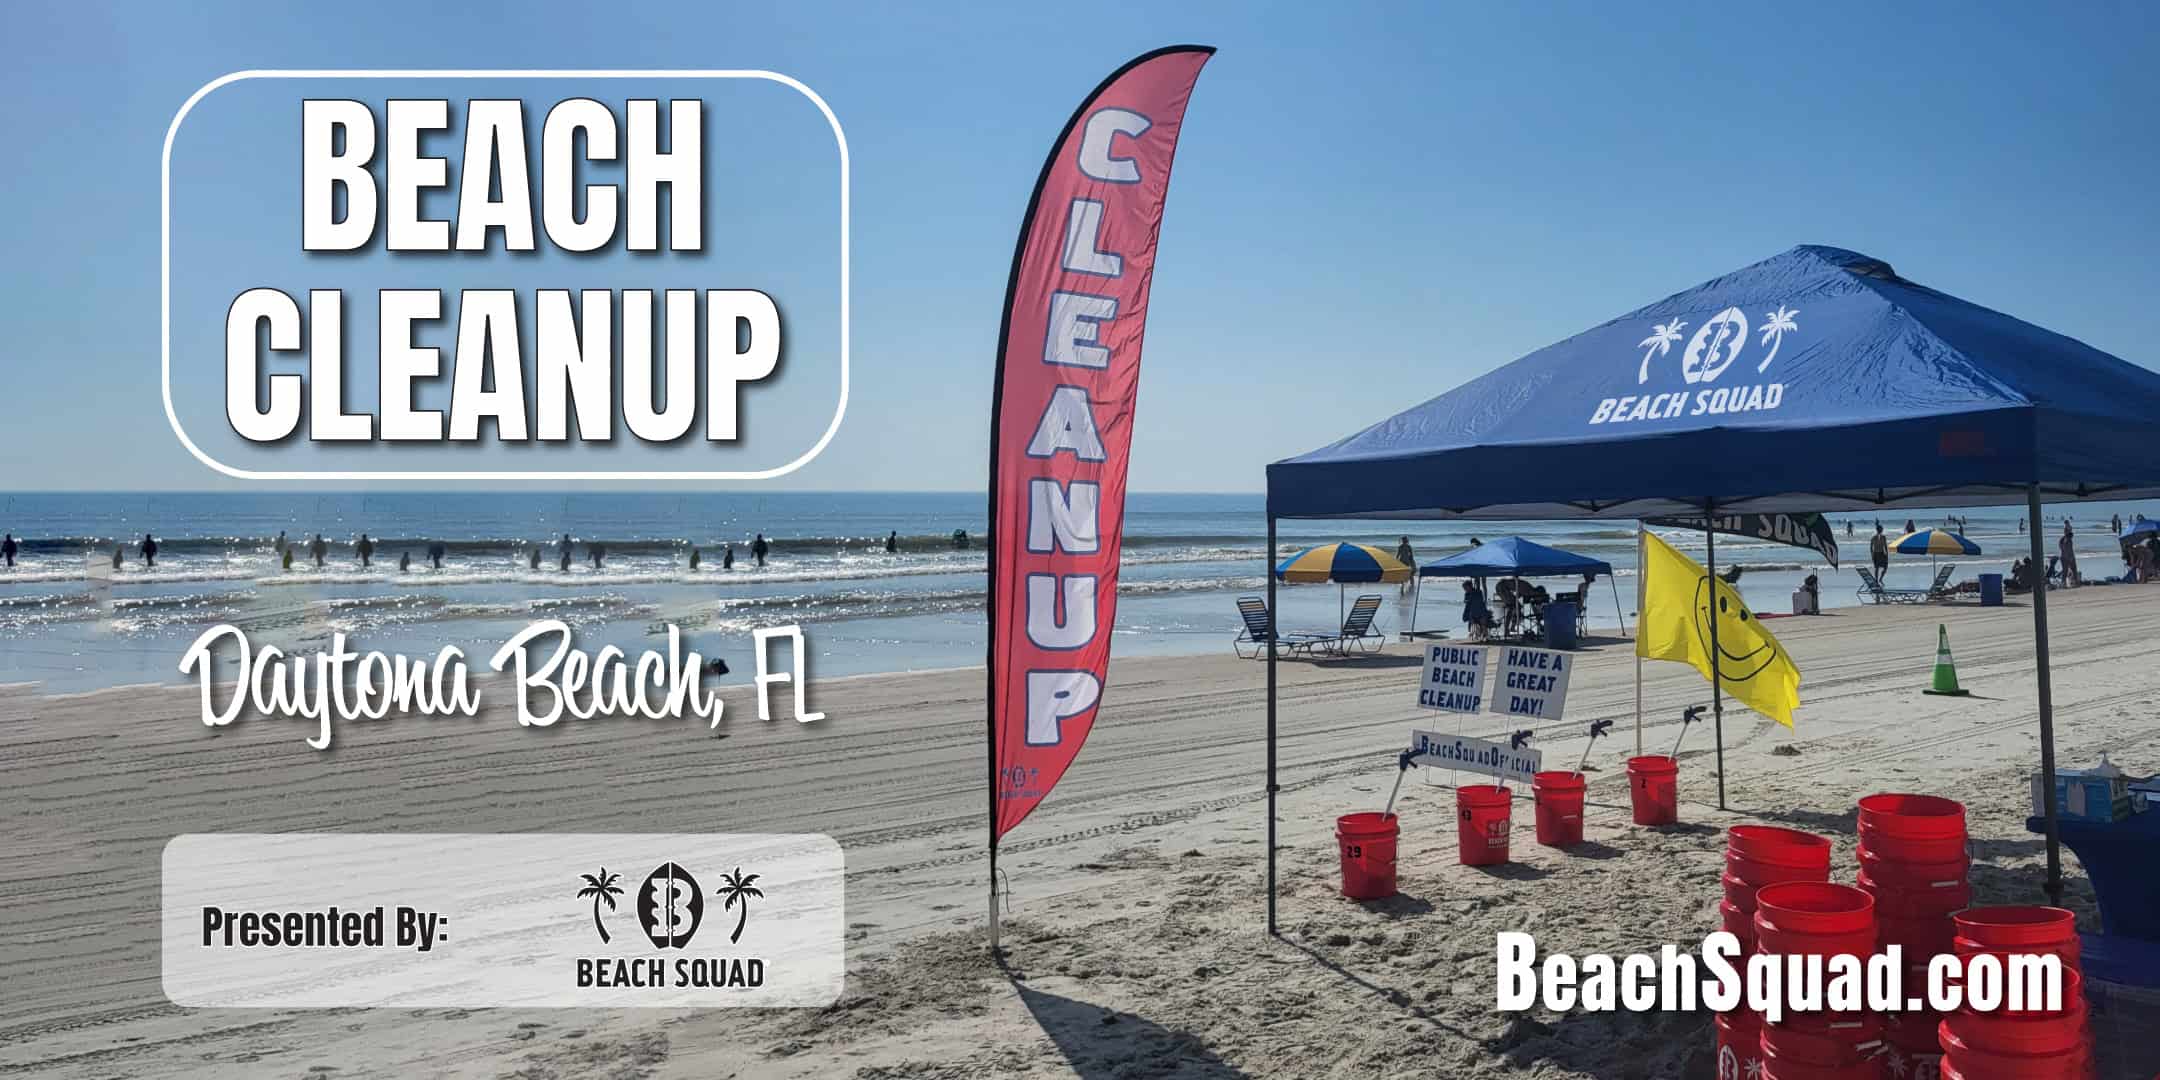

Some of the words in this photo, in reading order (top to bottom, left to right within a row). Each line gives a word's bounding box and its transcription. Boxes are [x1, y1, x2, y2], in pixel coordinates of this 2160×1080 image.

[1588, 391, 1690, 425] BEACH
[1690, 383, 1785, 417] SQUAD
[1024, 105, 1153, 748] CLEANUP
[1431, 646, 1480, 666] PUBLIC
[1507, 649, 1549, 670] HAVE
[1551, 654, 1563, 672] A
[1431, 667, 1476, 689] BEACH
[1506, 671, 1557, 693] GREAT
[1420, 689, 1481, 712] CLEANUP
[1509, 695, 1544, 716] DAY!
[1346, 845, 1362, 859] 29
